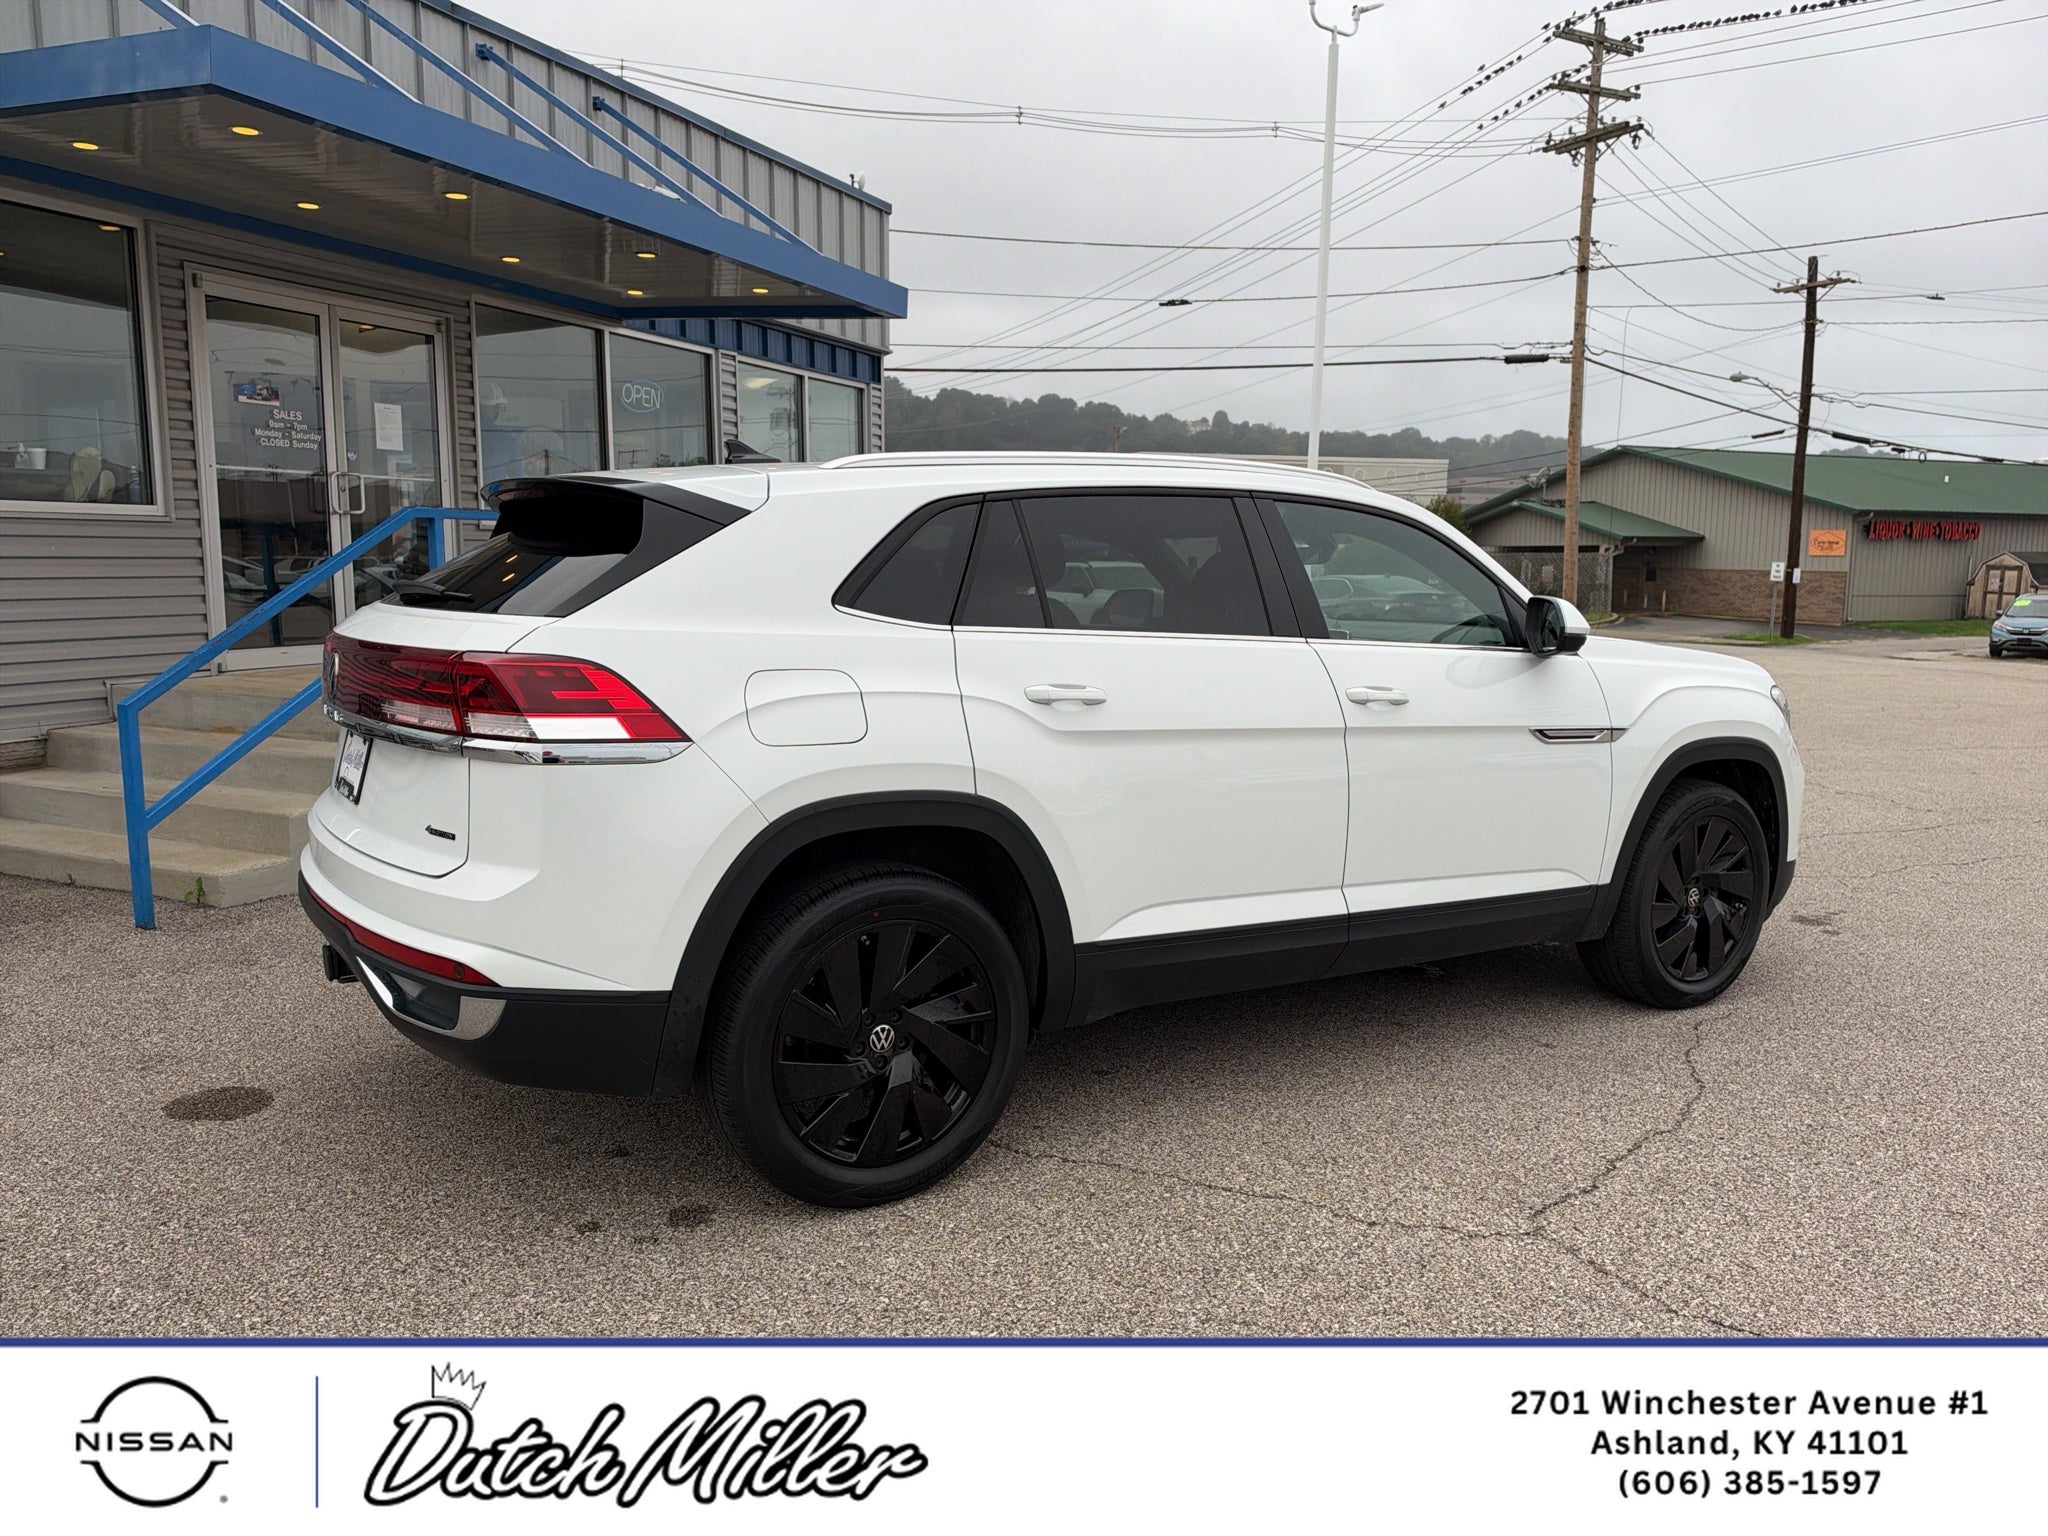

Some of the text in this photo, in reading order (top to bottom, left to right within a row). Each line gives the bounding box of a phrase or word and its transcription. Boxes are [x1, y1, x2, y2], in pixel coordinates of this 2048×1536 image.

[622, 383, 660, 409] OPEN
[273, 409, 303, 421] SALES
[293, 422, 308, 431] 7pm
[254, 428, 283, 438] Monday
[291, 431, 322, 442] Saturday
[260, 438, 318, 451] CLOSED Sunday
[1868, 520, 1982, 541] LIQUOR WINE TOBACCO
